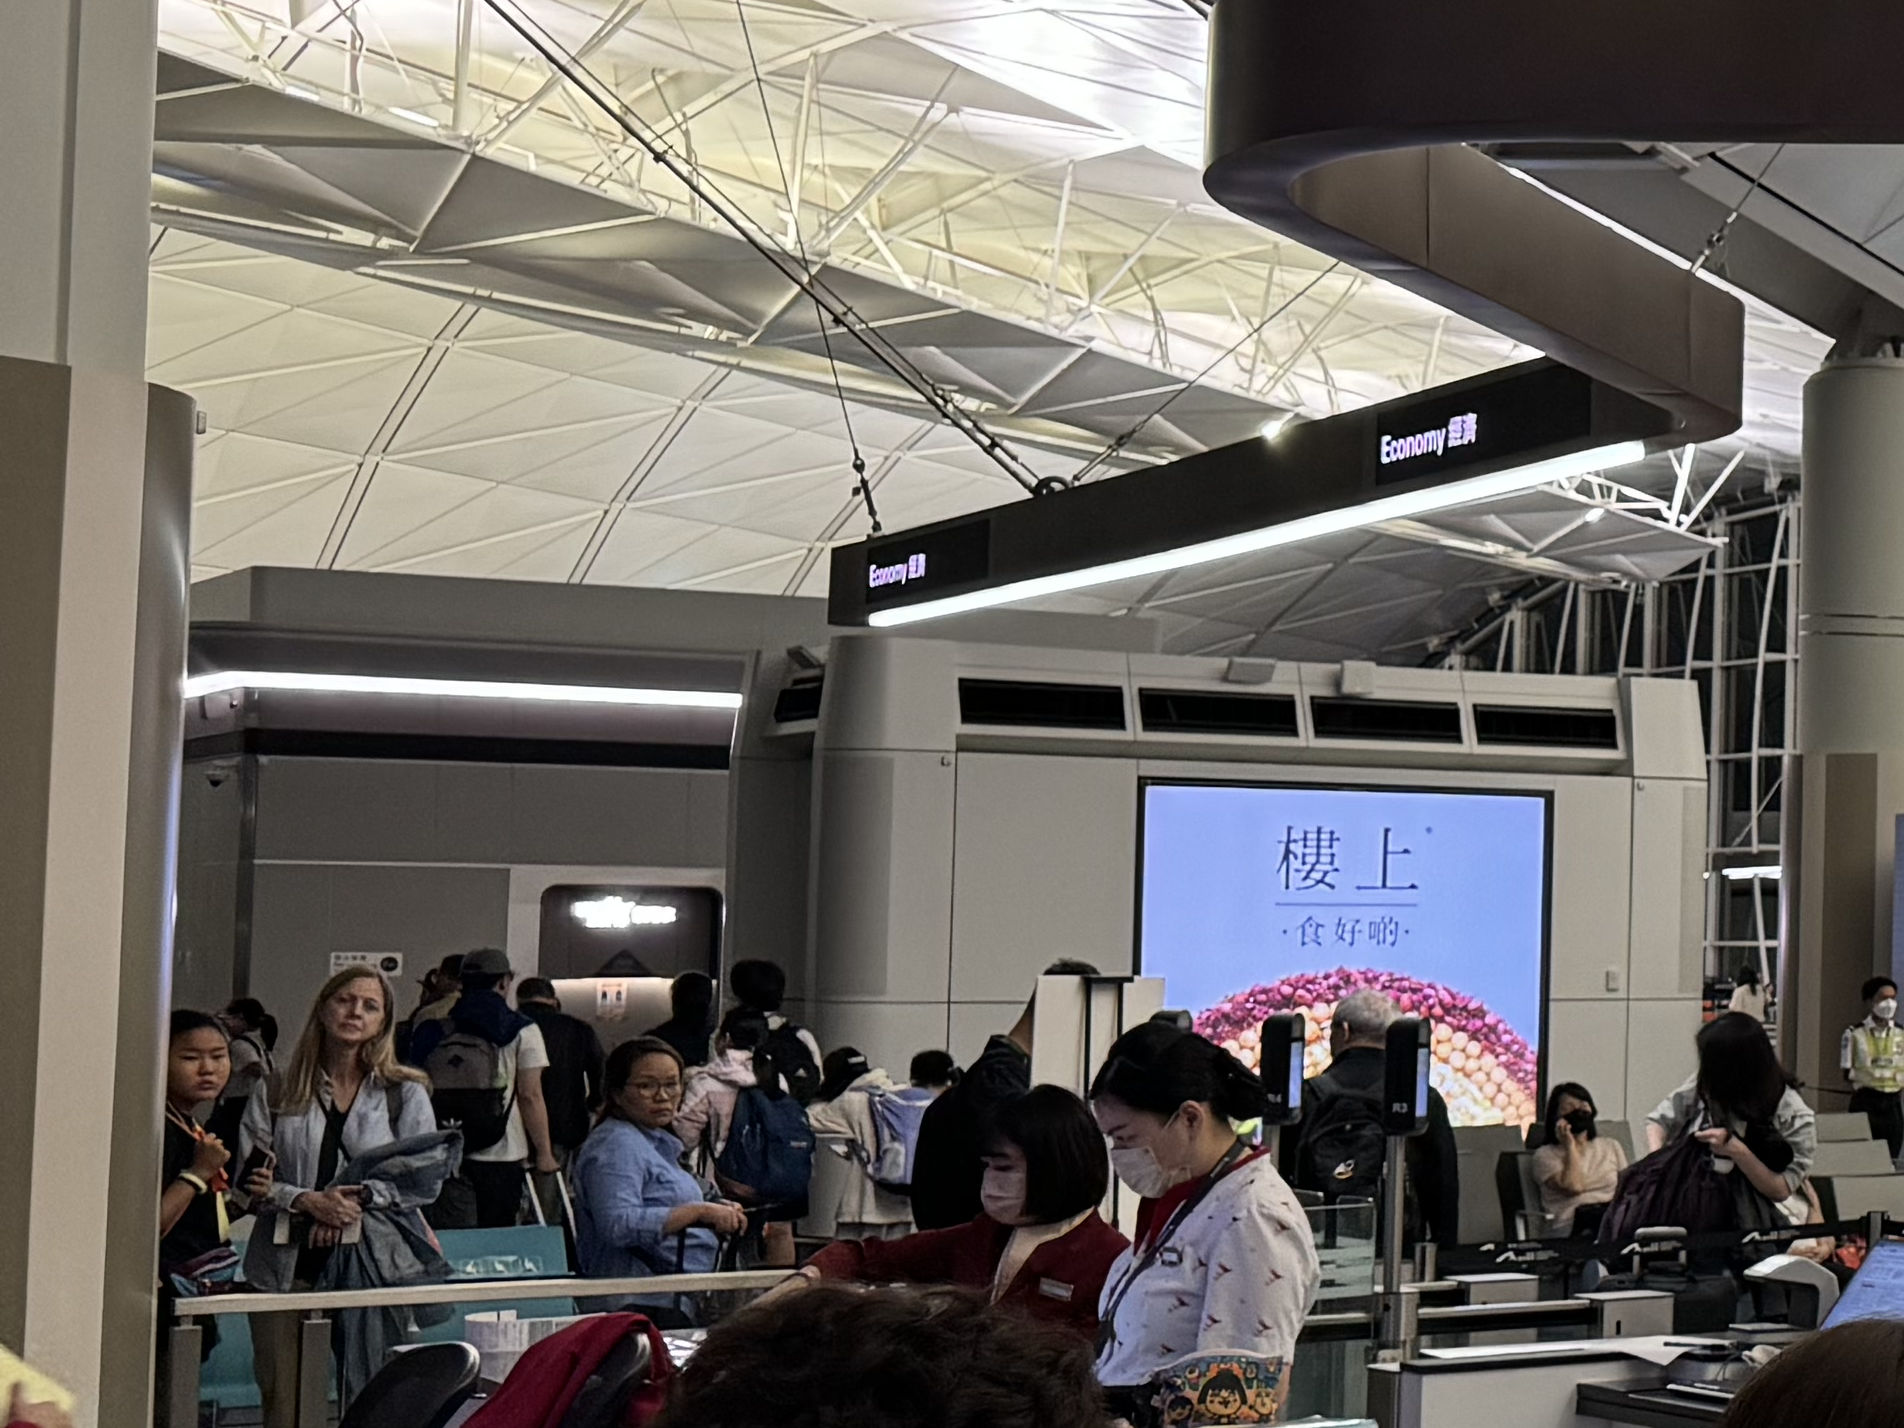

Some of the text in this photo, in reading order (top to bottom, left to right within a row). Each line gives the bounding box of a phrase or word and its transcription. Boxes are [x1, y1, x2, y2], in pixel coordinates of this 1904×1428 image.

[1380, 428, 1446, 465] Economy
[869, 562, 908, 588] Economy
[1276, 825, 1418, 891] 樓上
